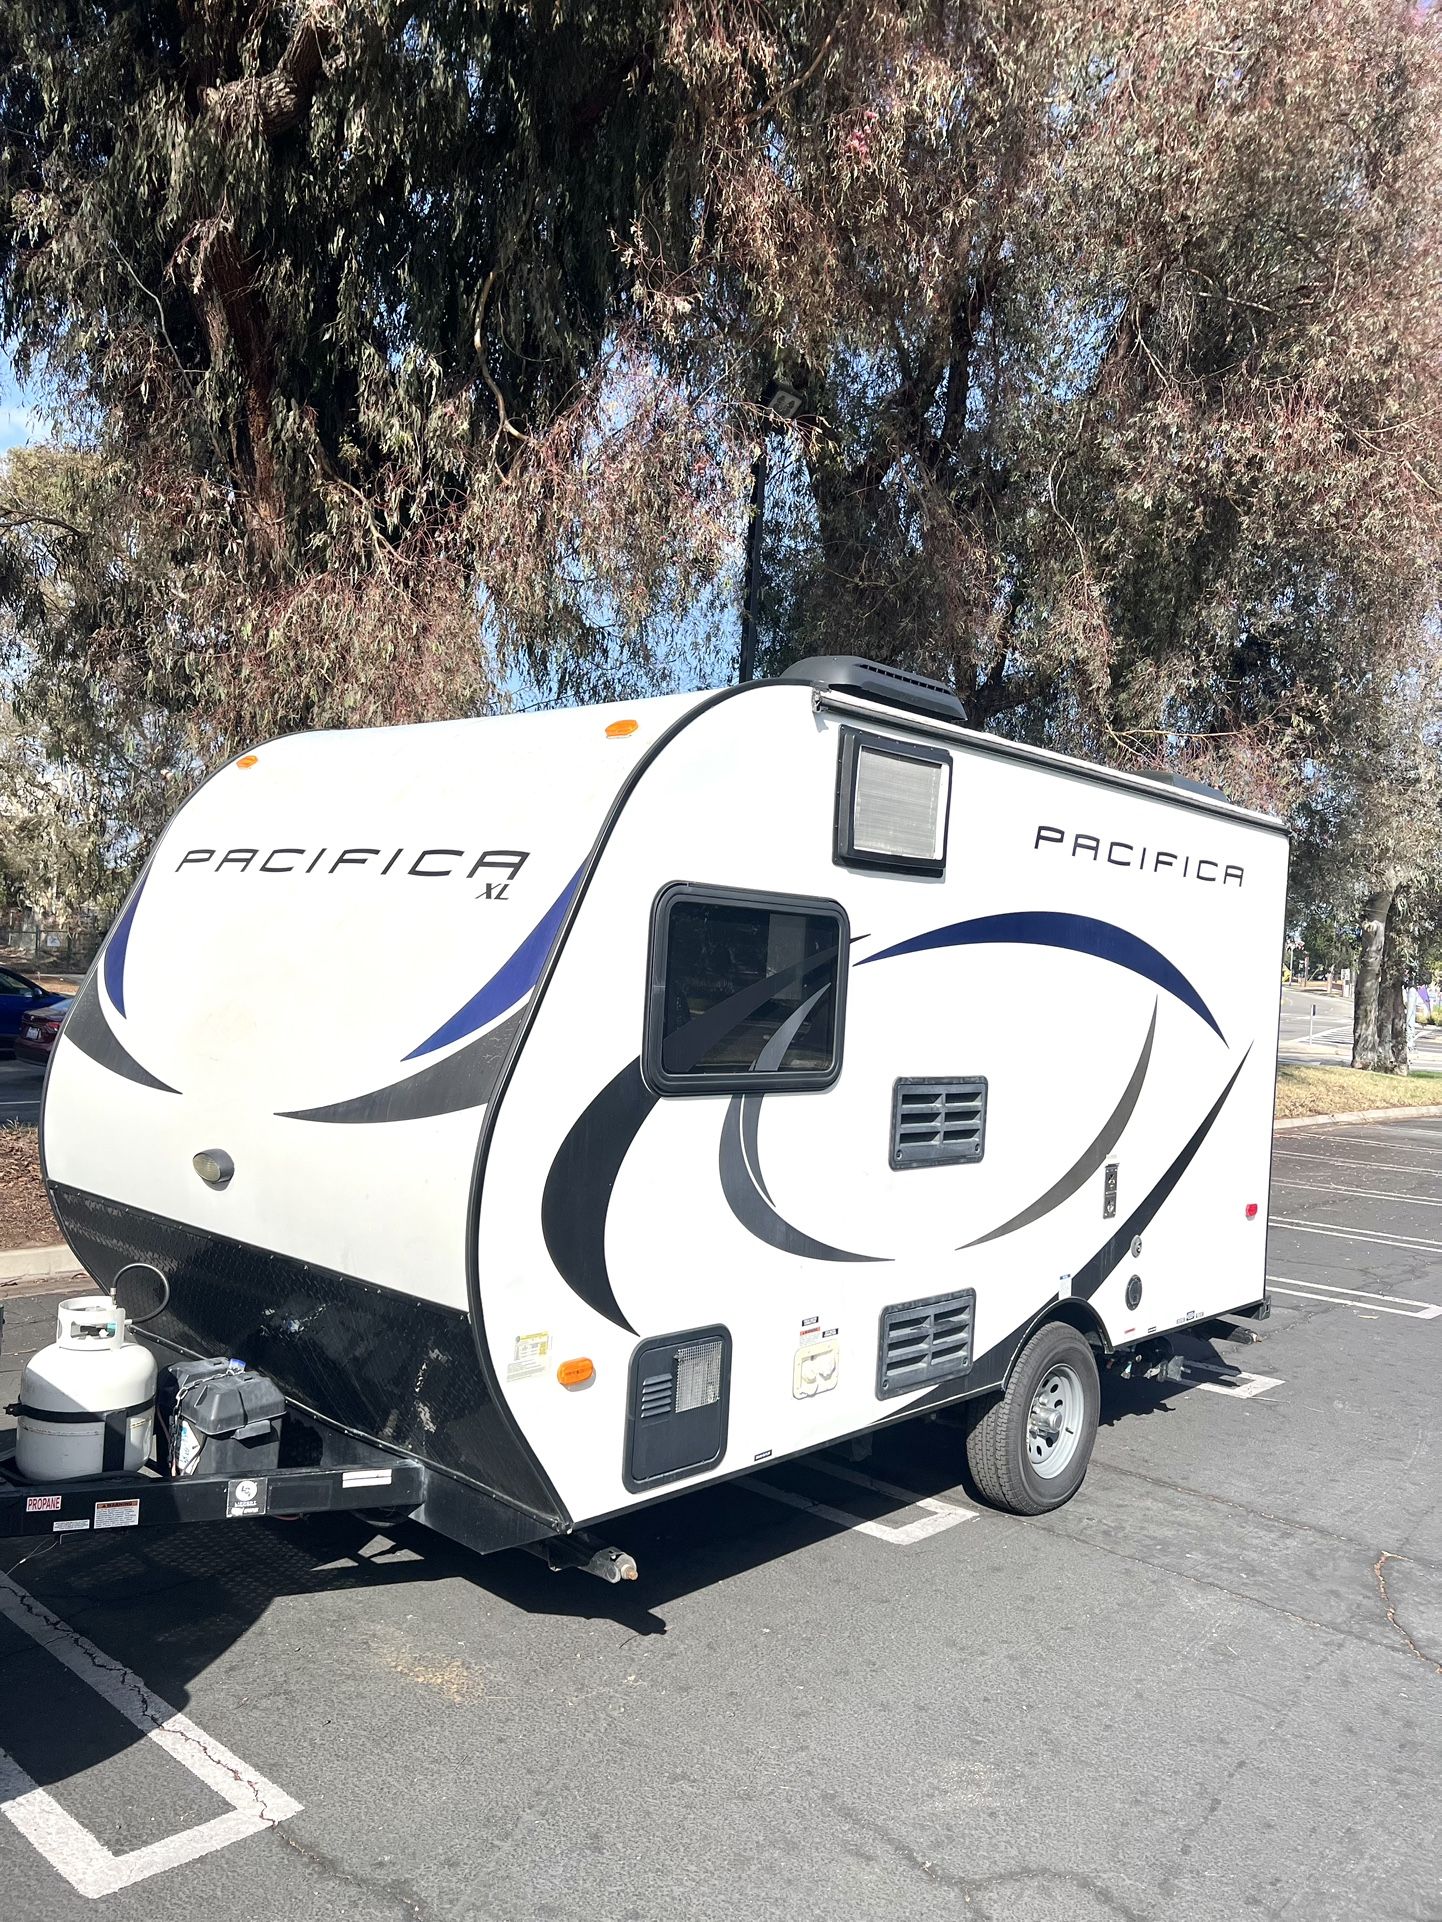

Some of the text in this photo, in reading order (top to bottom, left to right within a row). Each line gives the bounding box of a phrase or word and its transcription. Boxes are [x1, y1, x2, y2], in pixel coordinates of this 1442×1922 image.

[175, 847, 531, 880] PACIFICA
[1034, 825, 1244, 887] PACIFICA
[475, 883, 510, 900] XL
[27, 1497, 60, 1510] PROPANE
